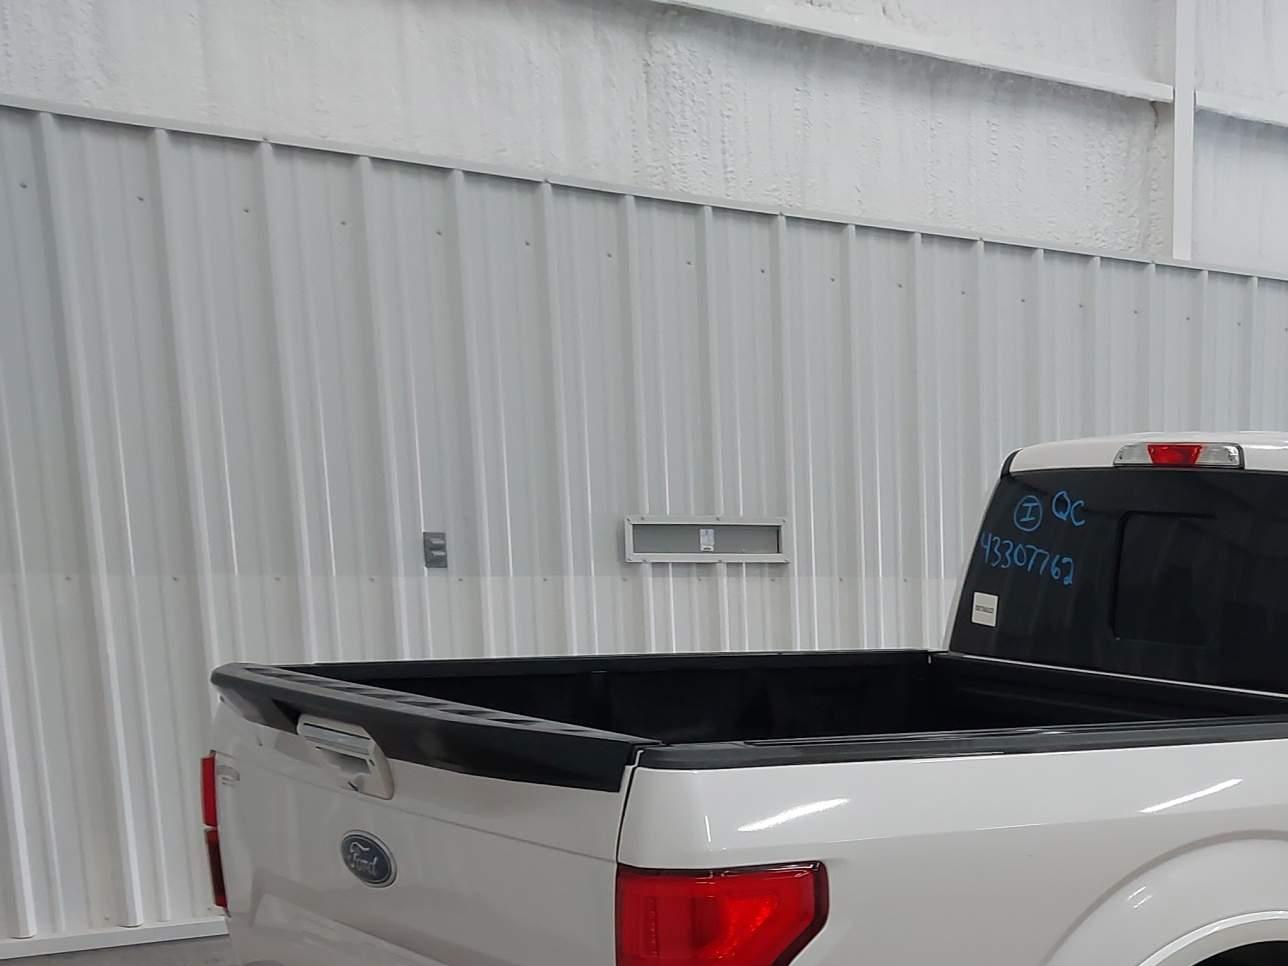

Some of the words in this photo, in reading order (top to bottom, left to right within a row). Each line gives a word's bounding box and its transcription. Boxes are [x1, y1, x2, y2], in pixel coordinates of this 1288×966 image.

[1052, 491, 1085, 526] QC
[981, 532, 1074, 585] 43307762
[348, 841, 378, 876] Ford
